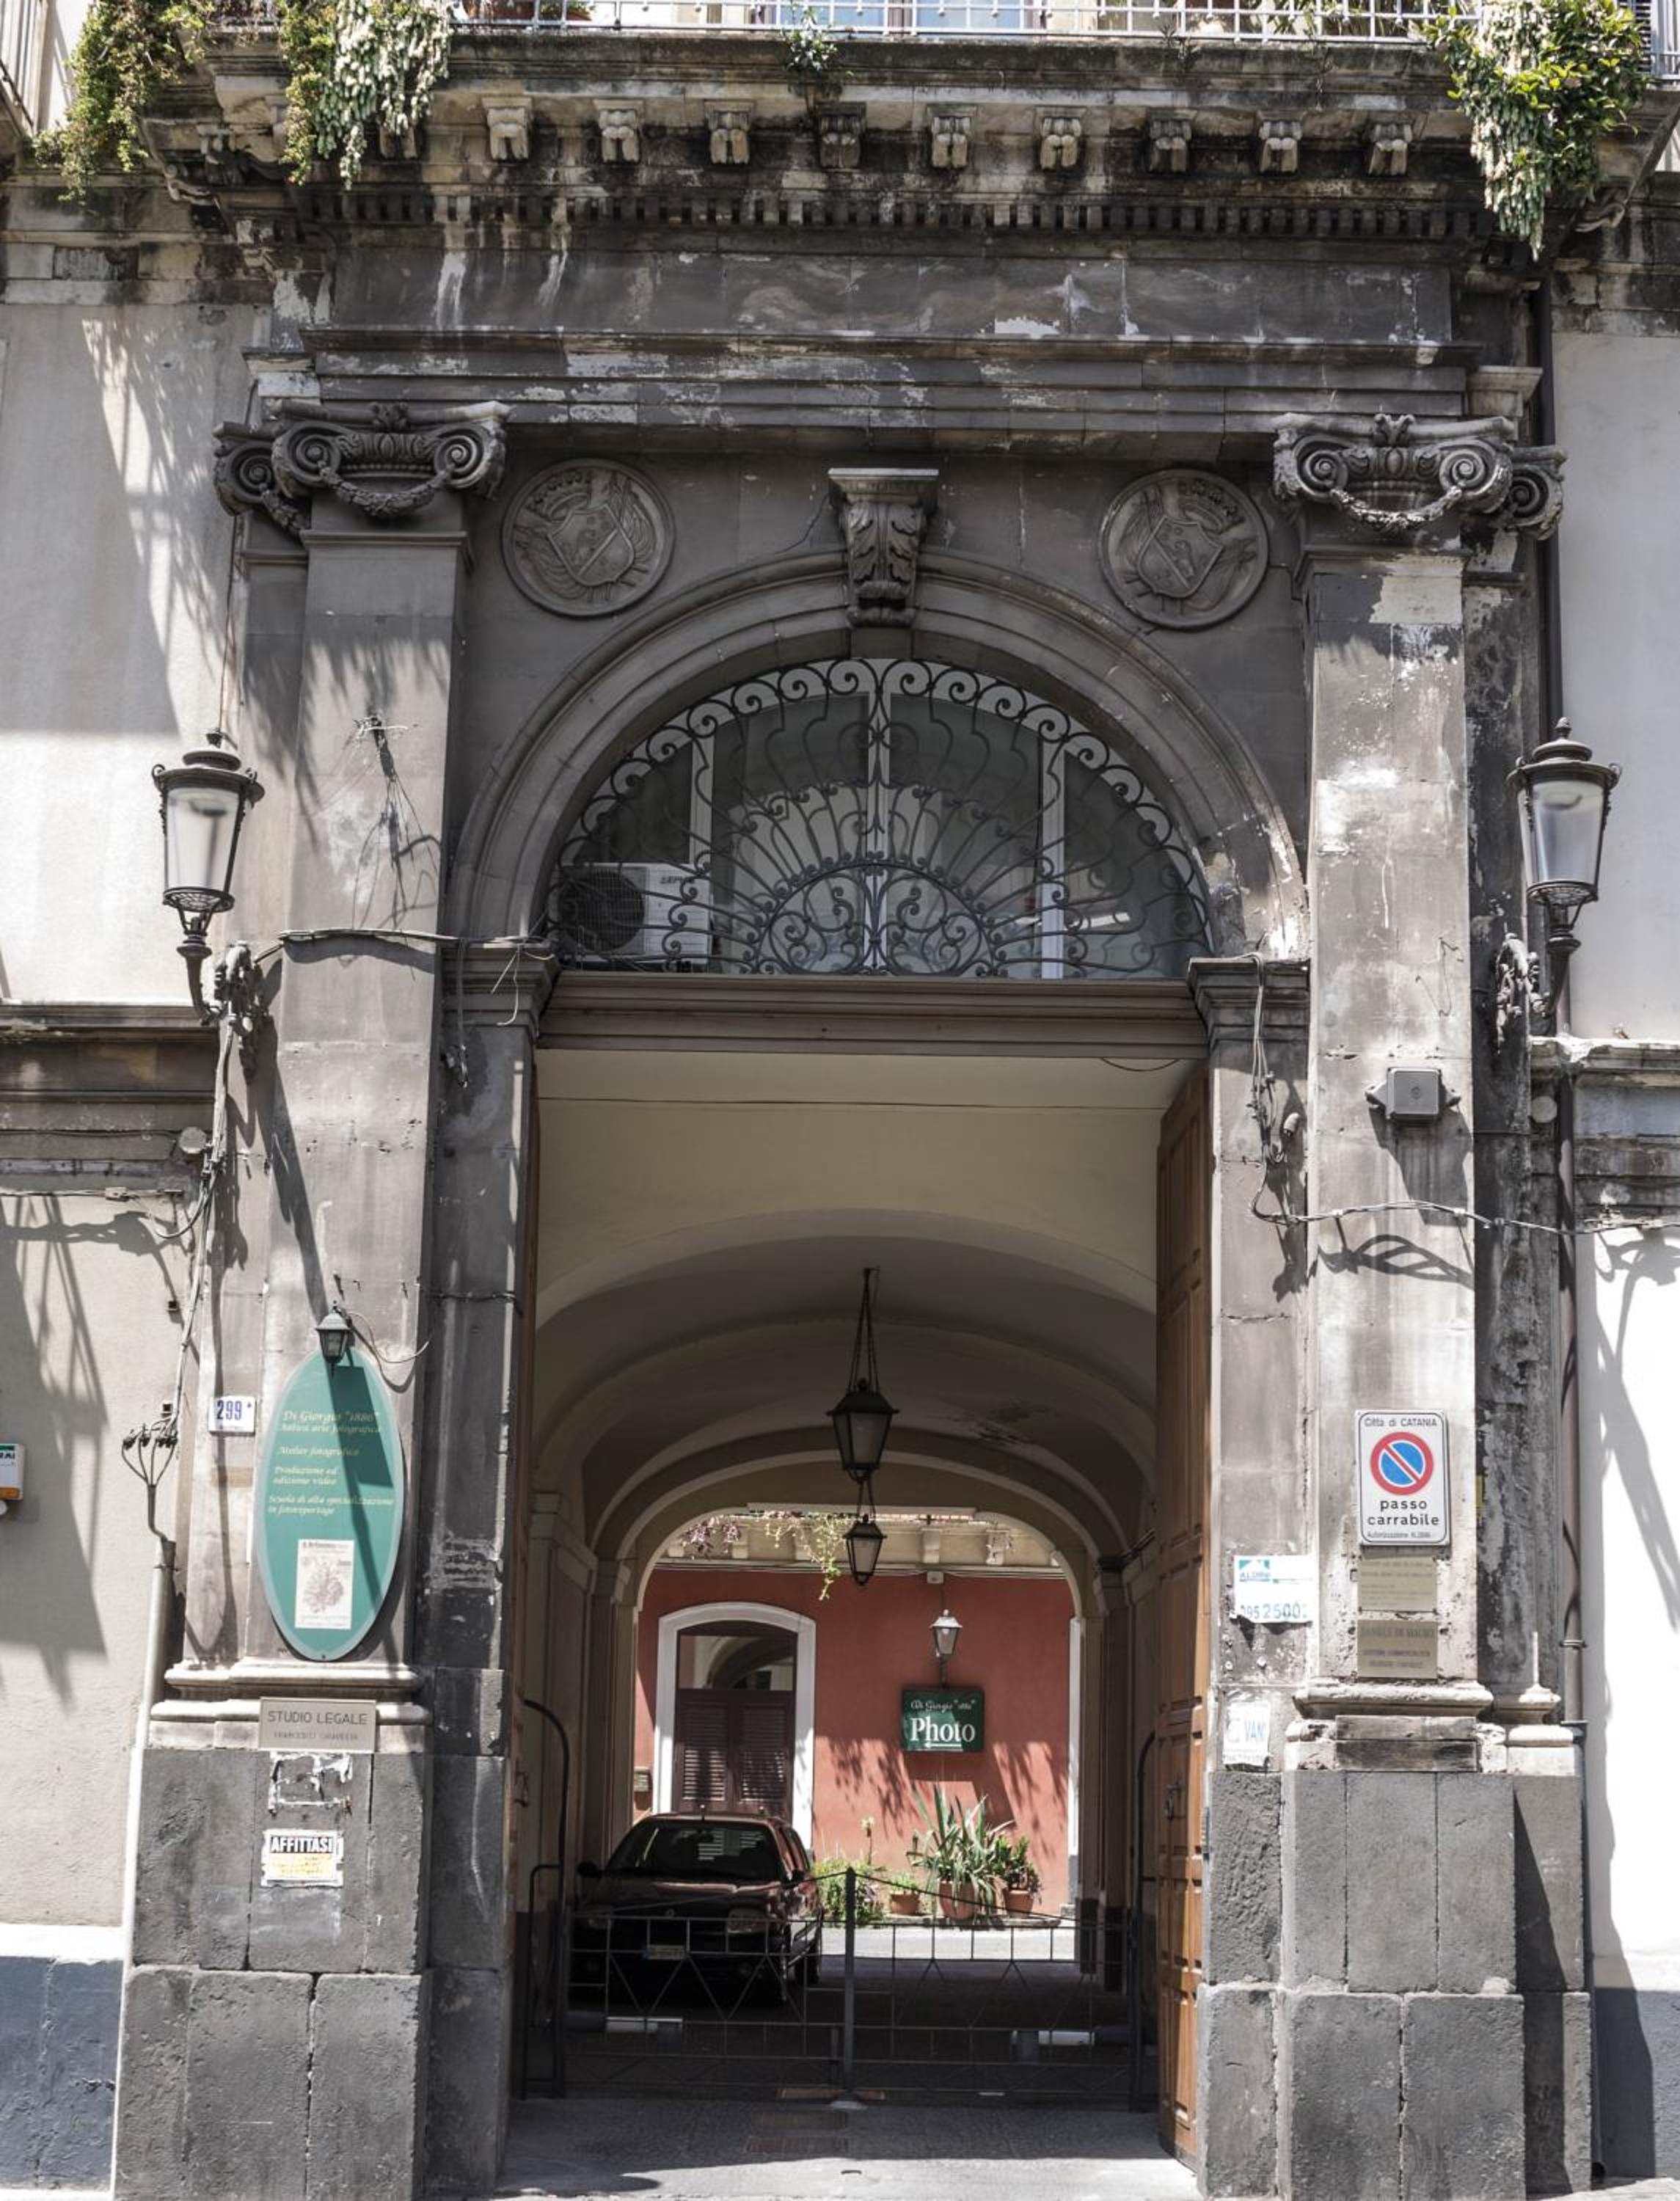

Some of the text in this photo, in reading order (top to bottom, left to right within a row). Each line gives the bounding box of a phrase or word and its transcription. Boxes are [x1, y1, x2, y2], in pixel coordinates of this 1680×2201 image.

[217, 1399, 242, 1420] 299
[1400, 1418, 1437, 1427] CATANIA
[1380, 1500, 1427, 1512] passo
[1367, 1514, 1439, 1525] carrabile
[268, 1710, 368, 1725] STUDIO LEGALE
[910, 1715, 975, 1742] Photo
[271, 1836, 333, 1853] AFFITTASI
